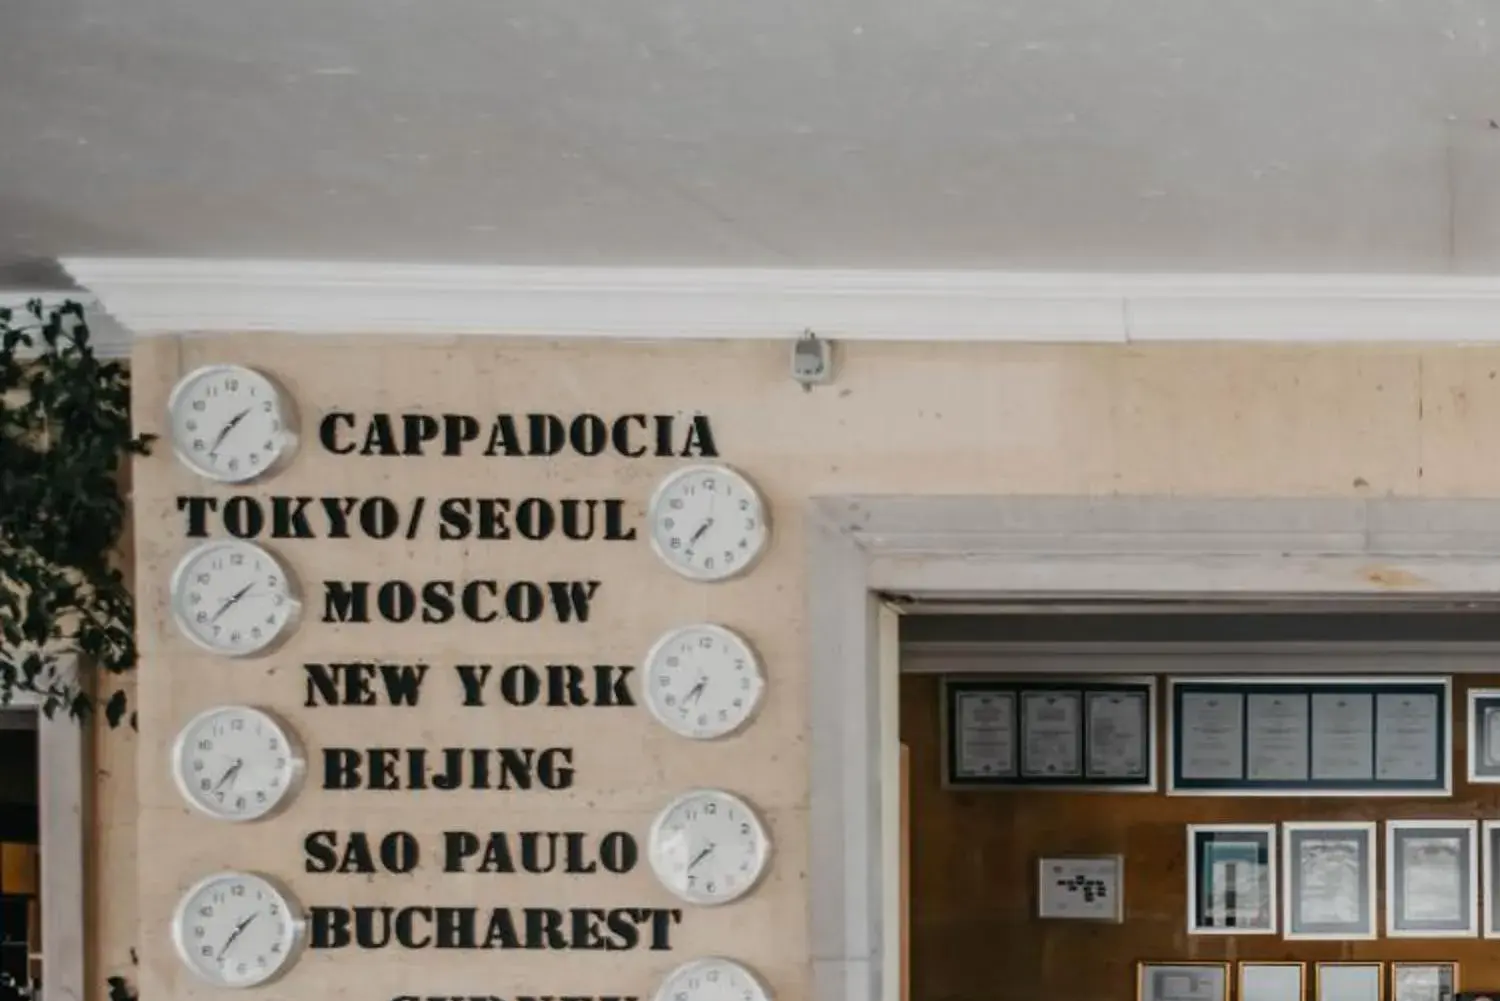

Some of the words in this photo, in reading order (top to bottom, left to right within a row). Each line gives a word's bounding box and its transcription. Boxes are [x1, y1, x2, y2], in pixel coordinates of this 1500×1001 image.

[320, 413, 718, 458] CAPPADOCIA
[177, 496, 637, 541] TOKYO/SEOUL
[322, 580, 600, 624] MOSCOW
[304, 663, 430, 708] NEW
[455, 664, 635, 708] YORK
[322, 747, 576, 791] BEIJING
[304, 830, 420, 874] SAO
[443, 831, 638, 874] PAULO
[308, 906, 682, 951] BUCHAREST
